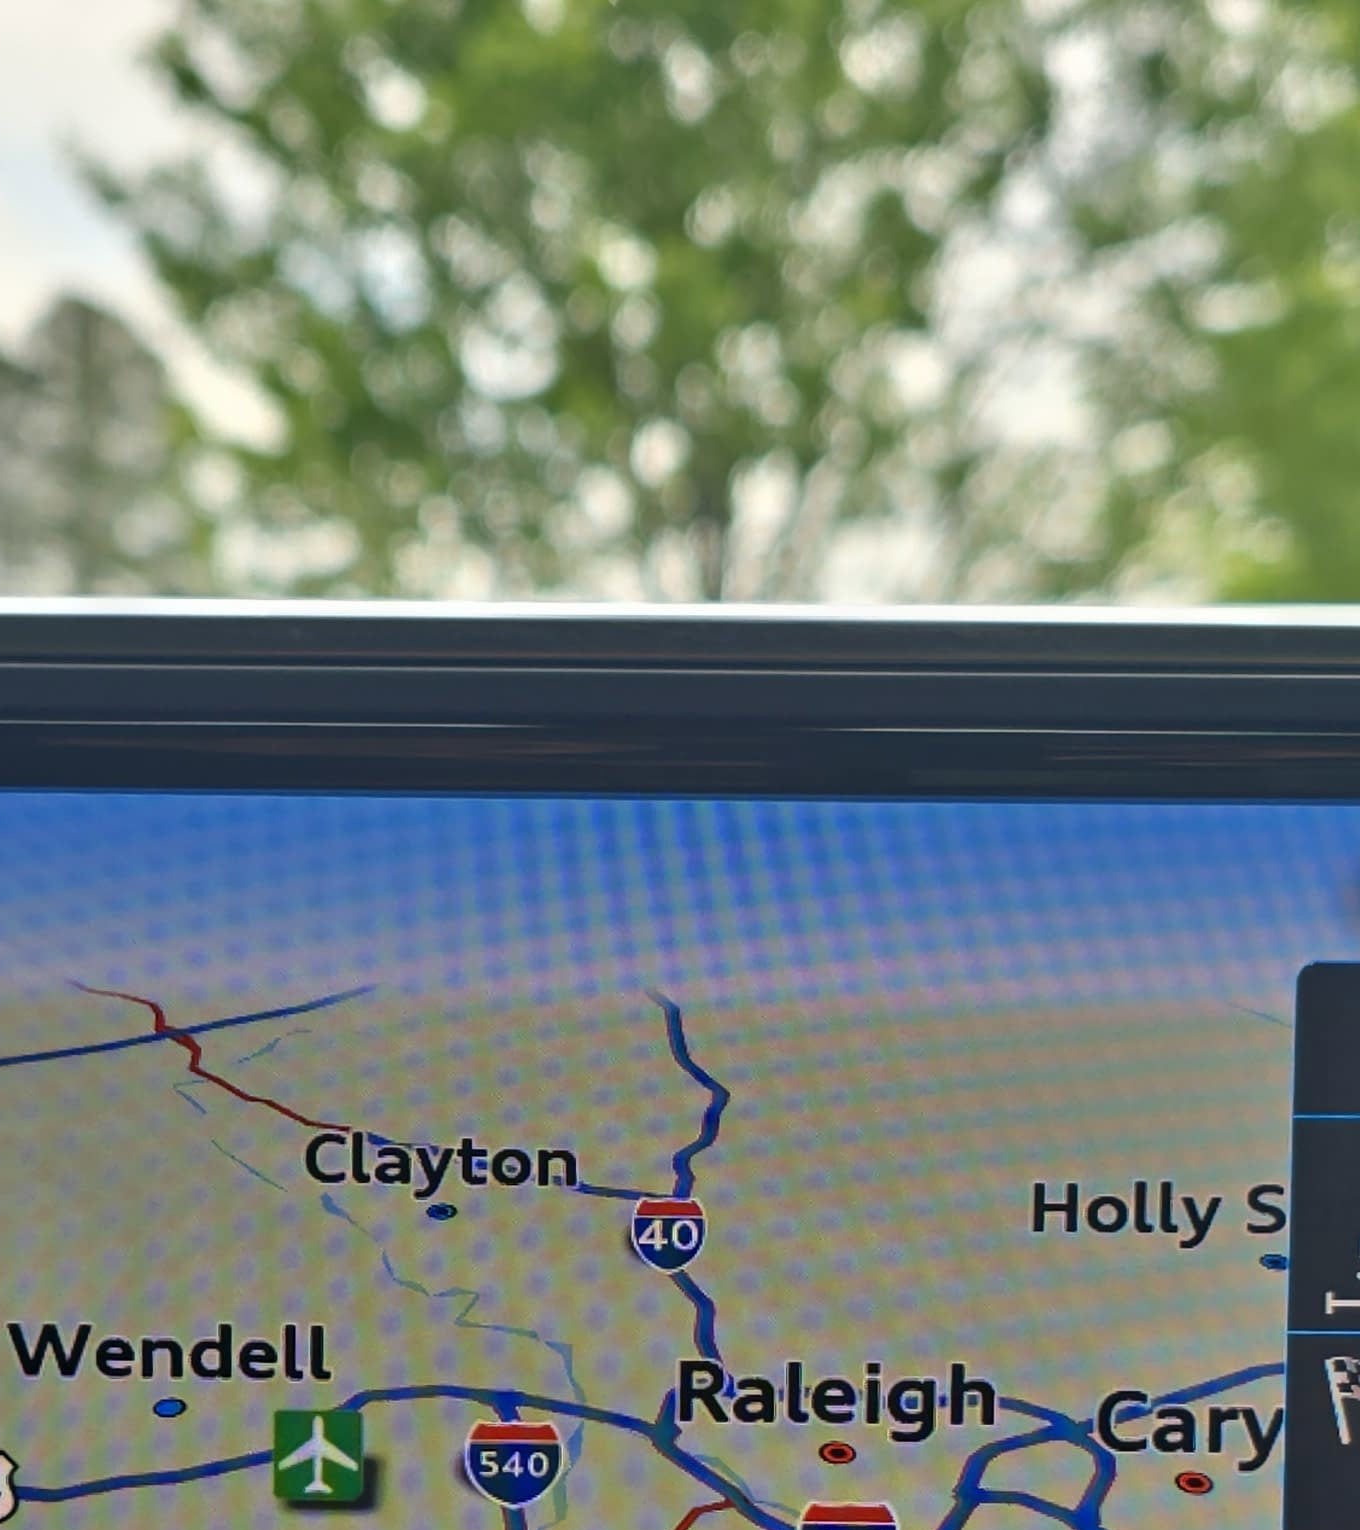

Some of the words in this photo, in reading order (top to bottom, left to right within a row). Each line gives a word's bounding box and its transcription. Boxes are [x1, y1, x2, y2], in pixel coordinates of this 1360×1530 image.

[305, 1132, 579, 1199] Clayton
[638, 1219, 700, 1250] 40
[1033, 1180, 1223, 1249] Holly
[9, 1323, 332, 1381] Wendell
[678, 1360, 997, 1442] Raleigh
[1098, 1390, 1284, 1472] Cary
[478, 1450, 550, 1479] 540
